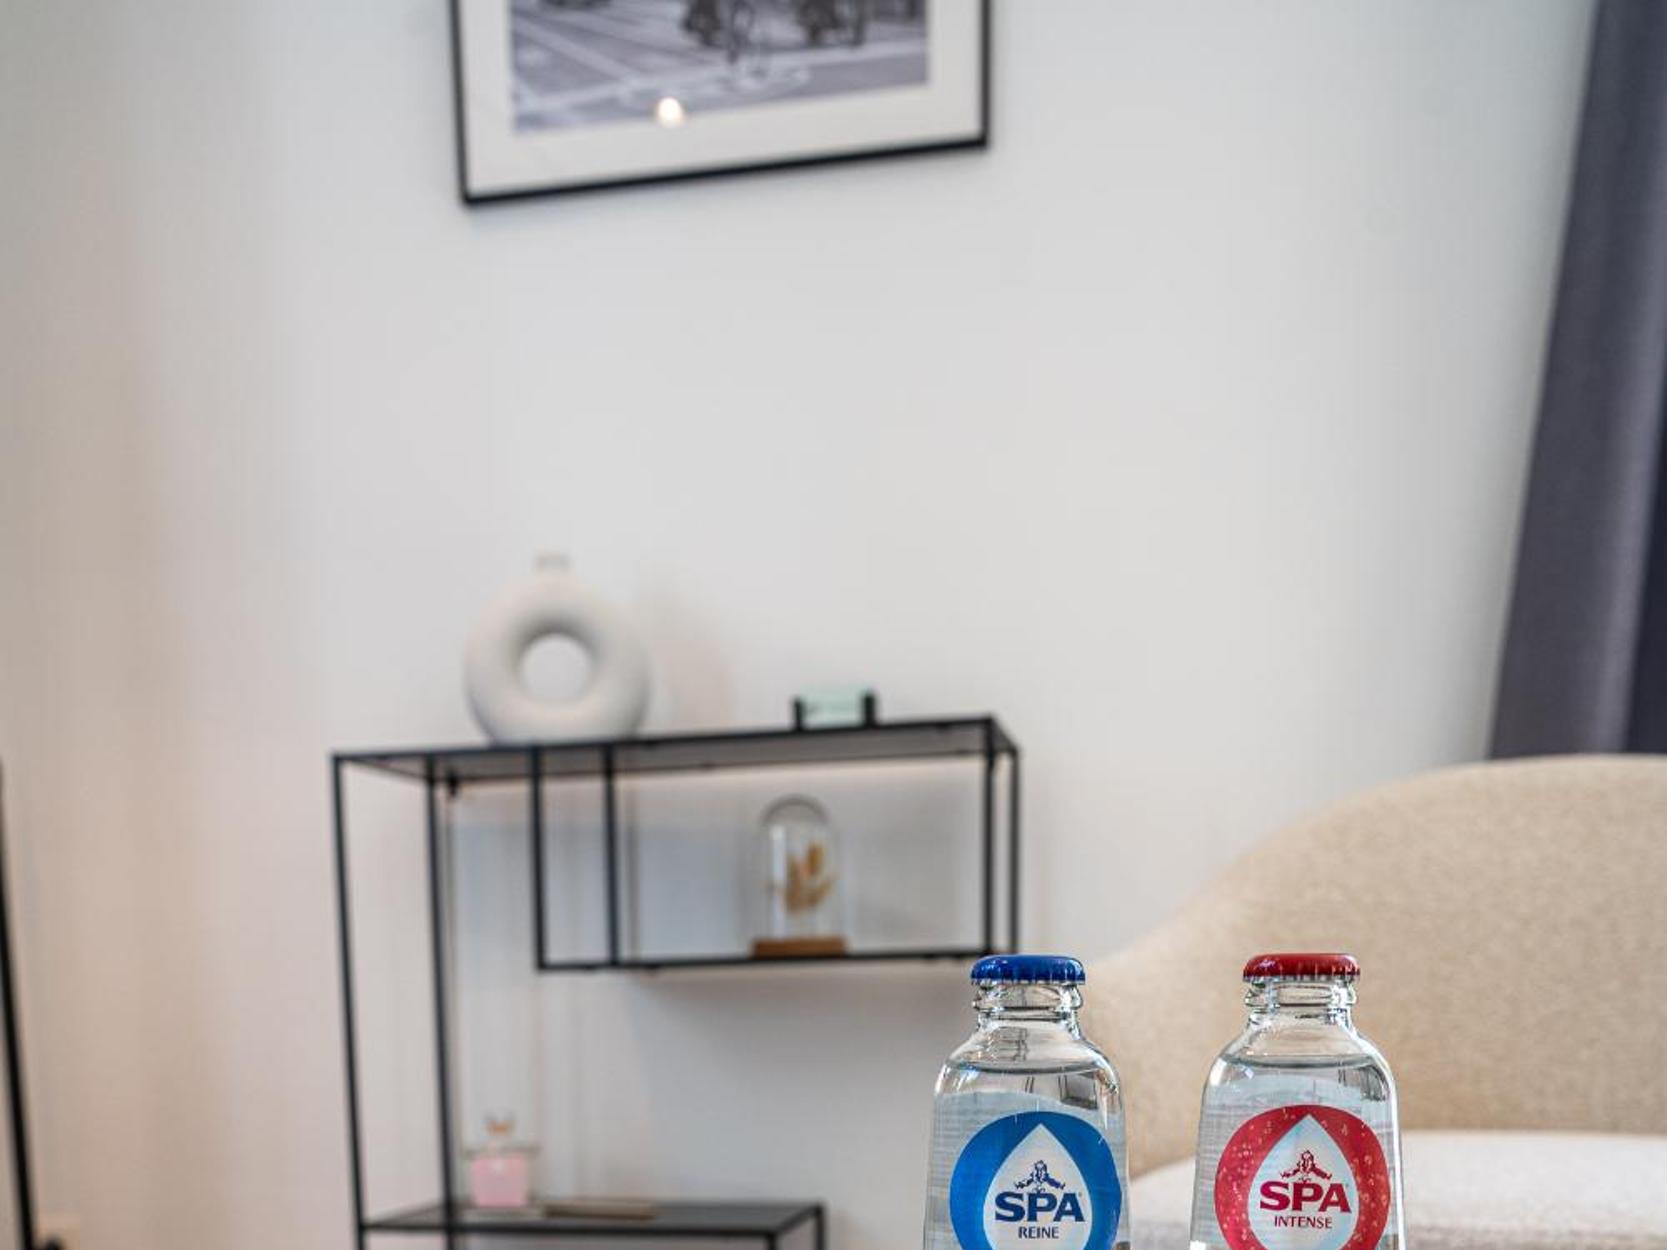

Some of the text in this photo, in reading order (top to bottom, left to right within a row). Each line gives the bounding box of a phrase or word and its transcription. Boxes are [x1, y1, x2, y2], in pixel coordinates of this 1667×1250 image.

[994, 1191, 1086, 1222] SPA
[1259, 1180, 1352, 1213] SPA
[1017, 1226, 1060, 1240] REINE
[1274, 1215, 1333, 1229] INTENSE
